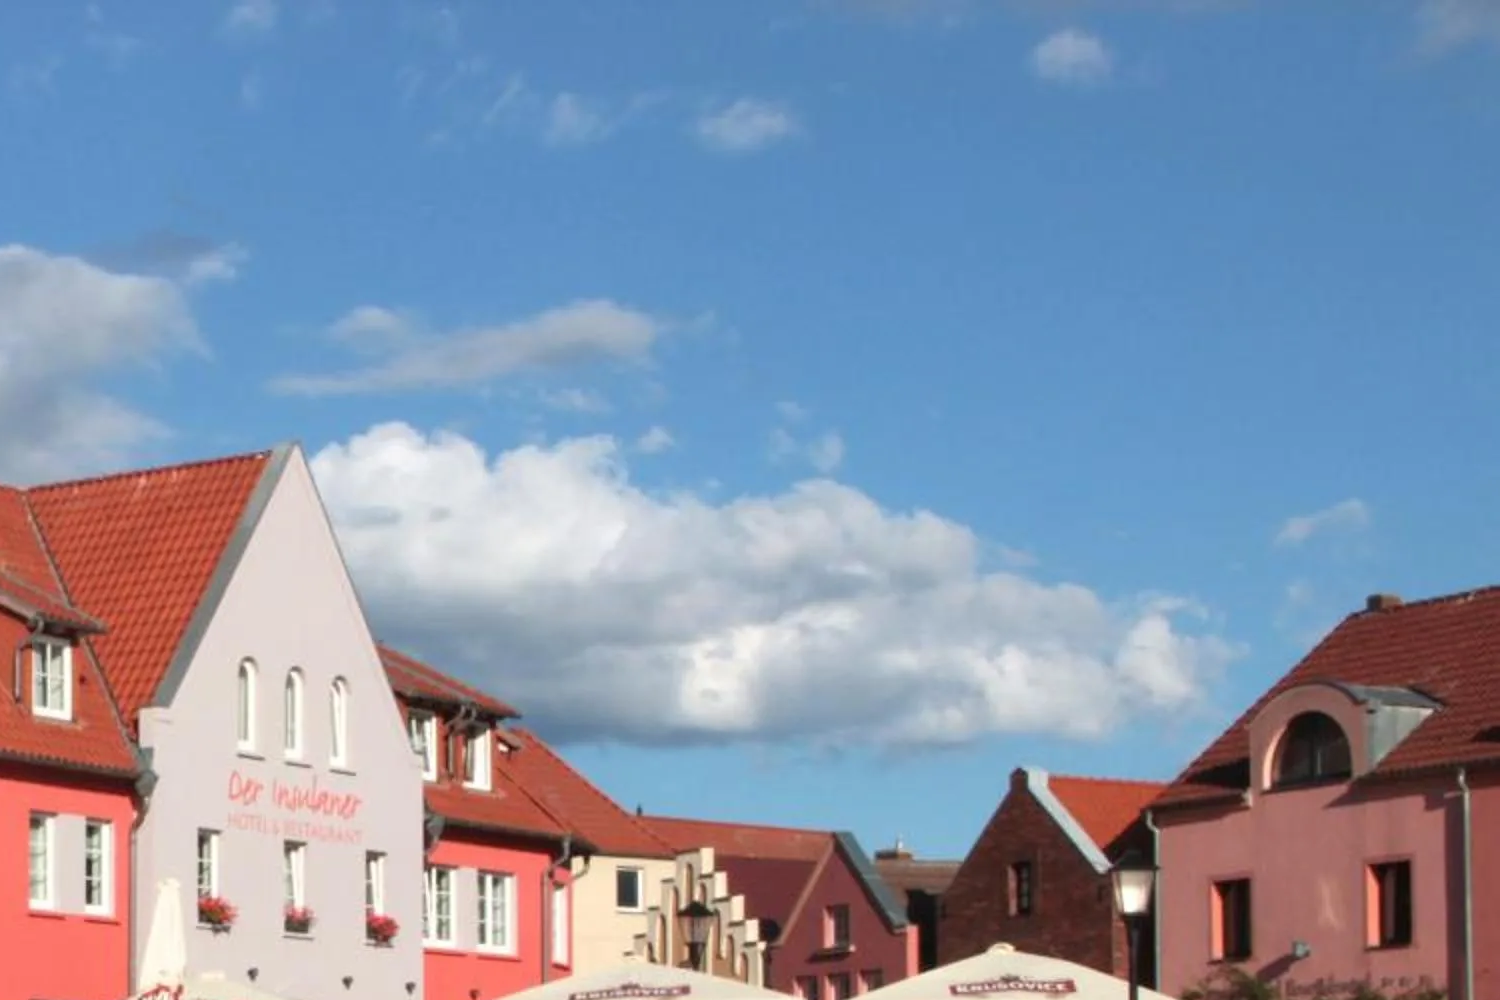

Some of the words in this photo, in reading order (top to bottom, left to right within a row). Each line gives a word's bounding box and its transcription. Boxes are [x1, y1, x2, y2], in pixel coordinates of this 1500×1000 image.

[227, 769, 264, 806] Der
[272, 774, 363, 820] Insulaner
[227, 812, 267, 834] HOTEL
